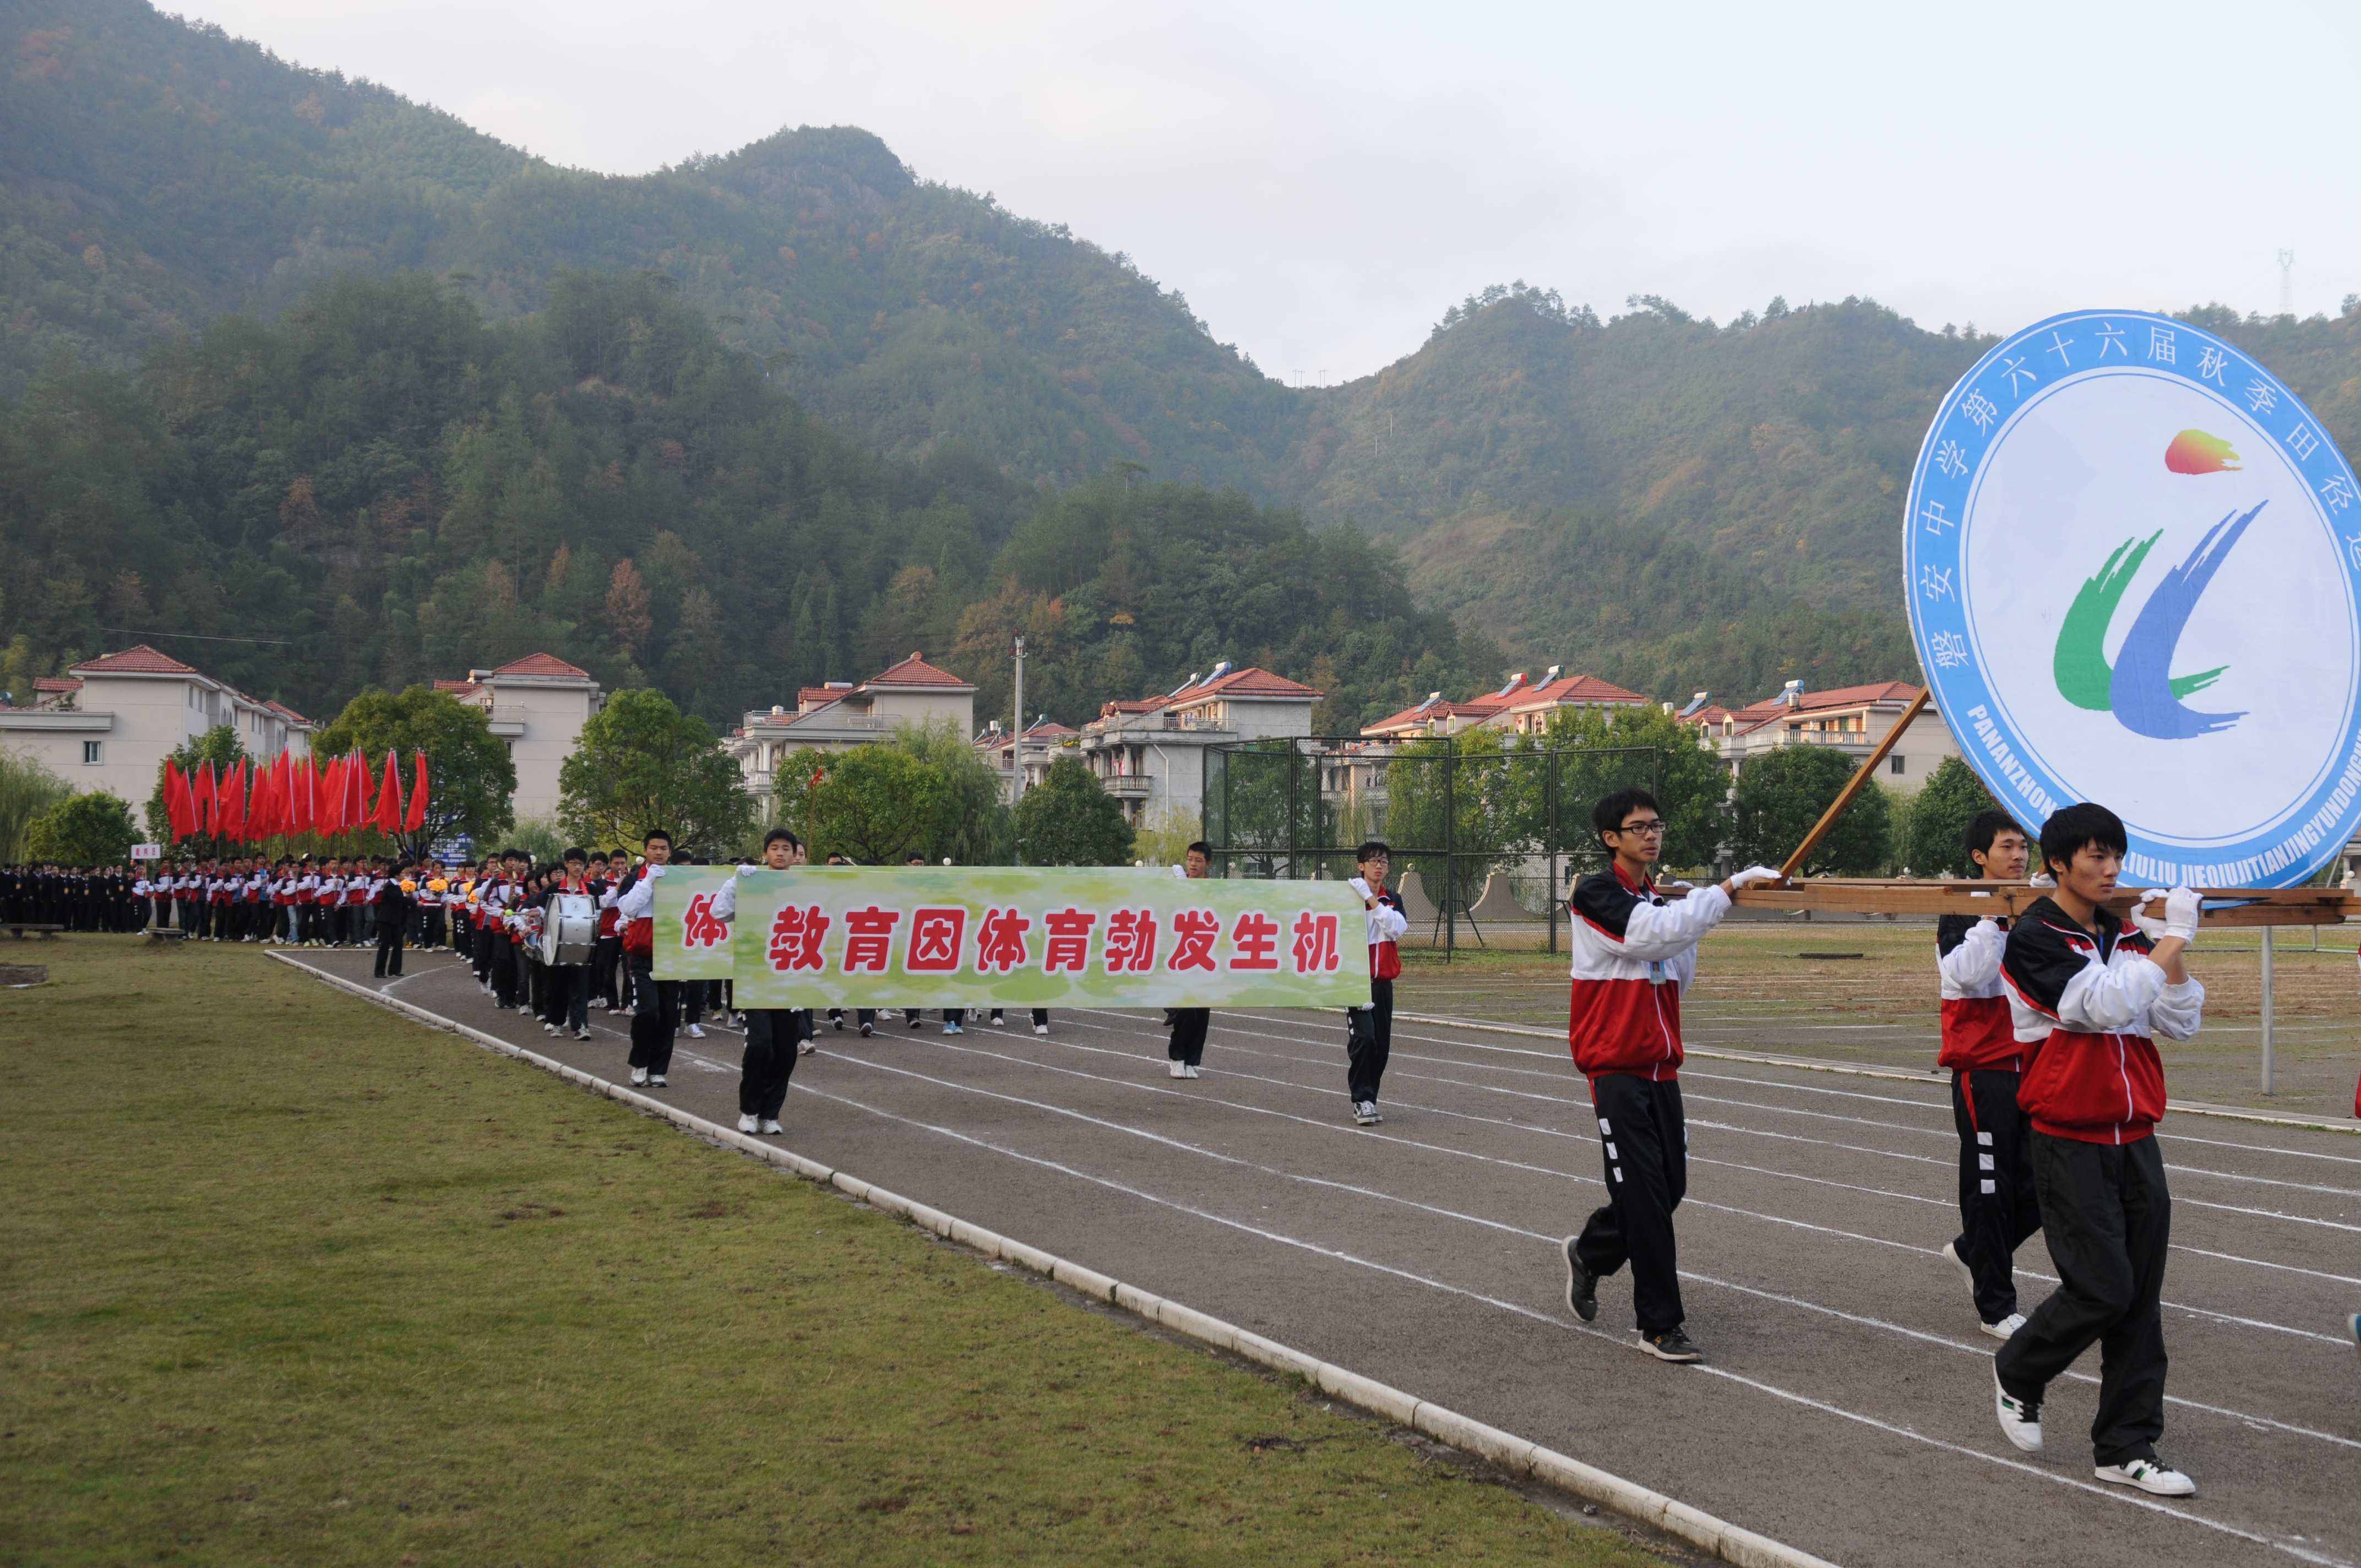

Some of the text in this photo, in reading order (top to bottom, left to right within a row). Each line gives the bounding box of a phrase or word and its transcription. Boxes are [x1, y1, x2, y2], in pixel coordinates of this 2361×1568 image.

[1967, 704, 2060, 820] PANANZHON
[2181, 729, 2361, 888] JIEQIUJITIANJINGYUNDONG
[769, 905, 1340, 973] 教育因体育勃发生机
